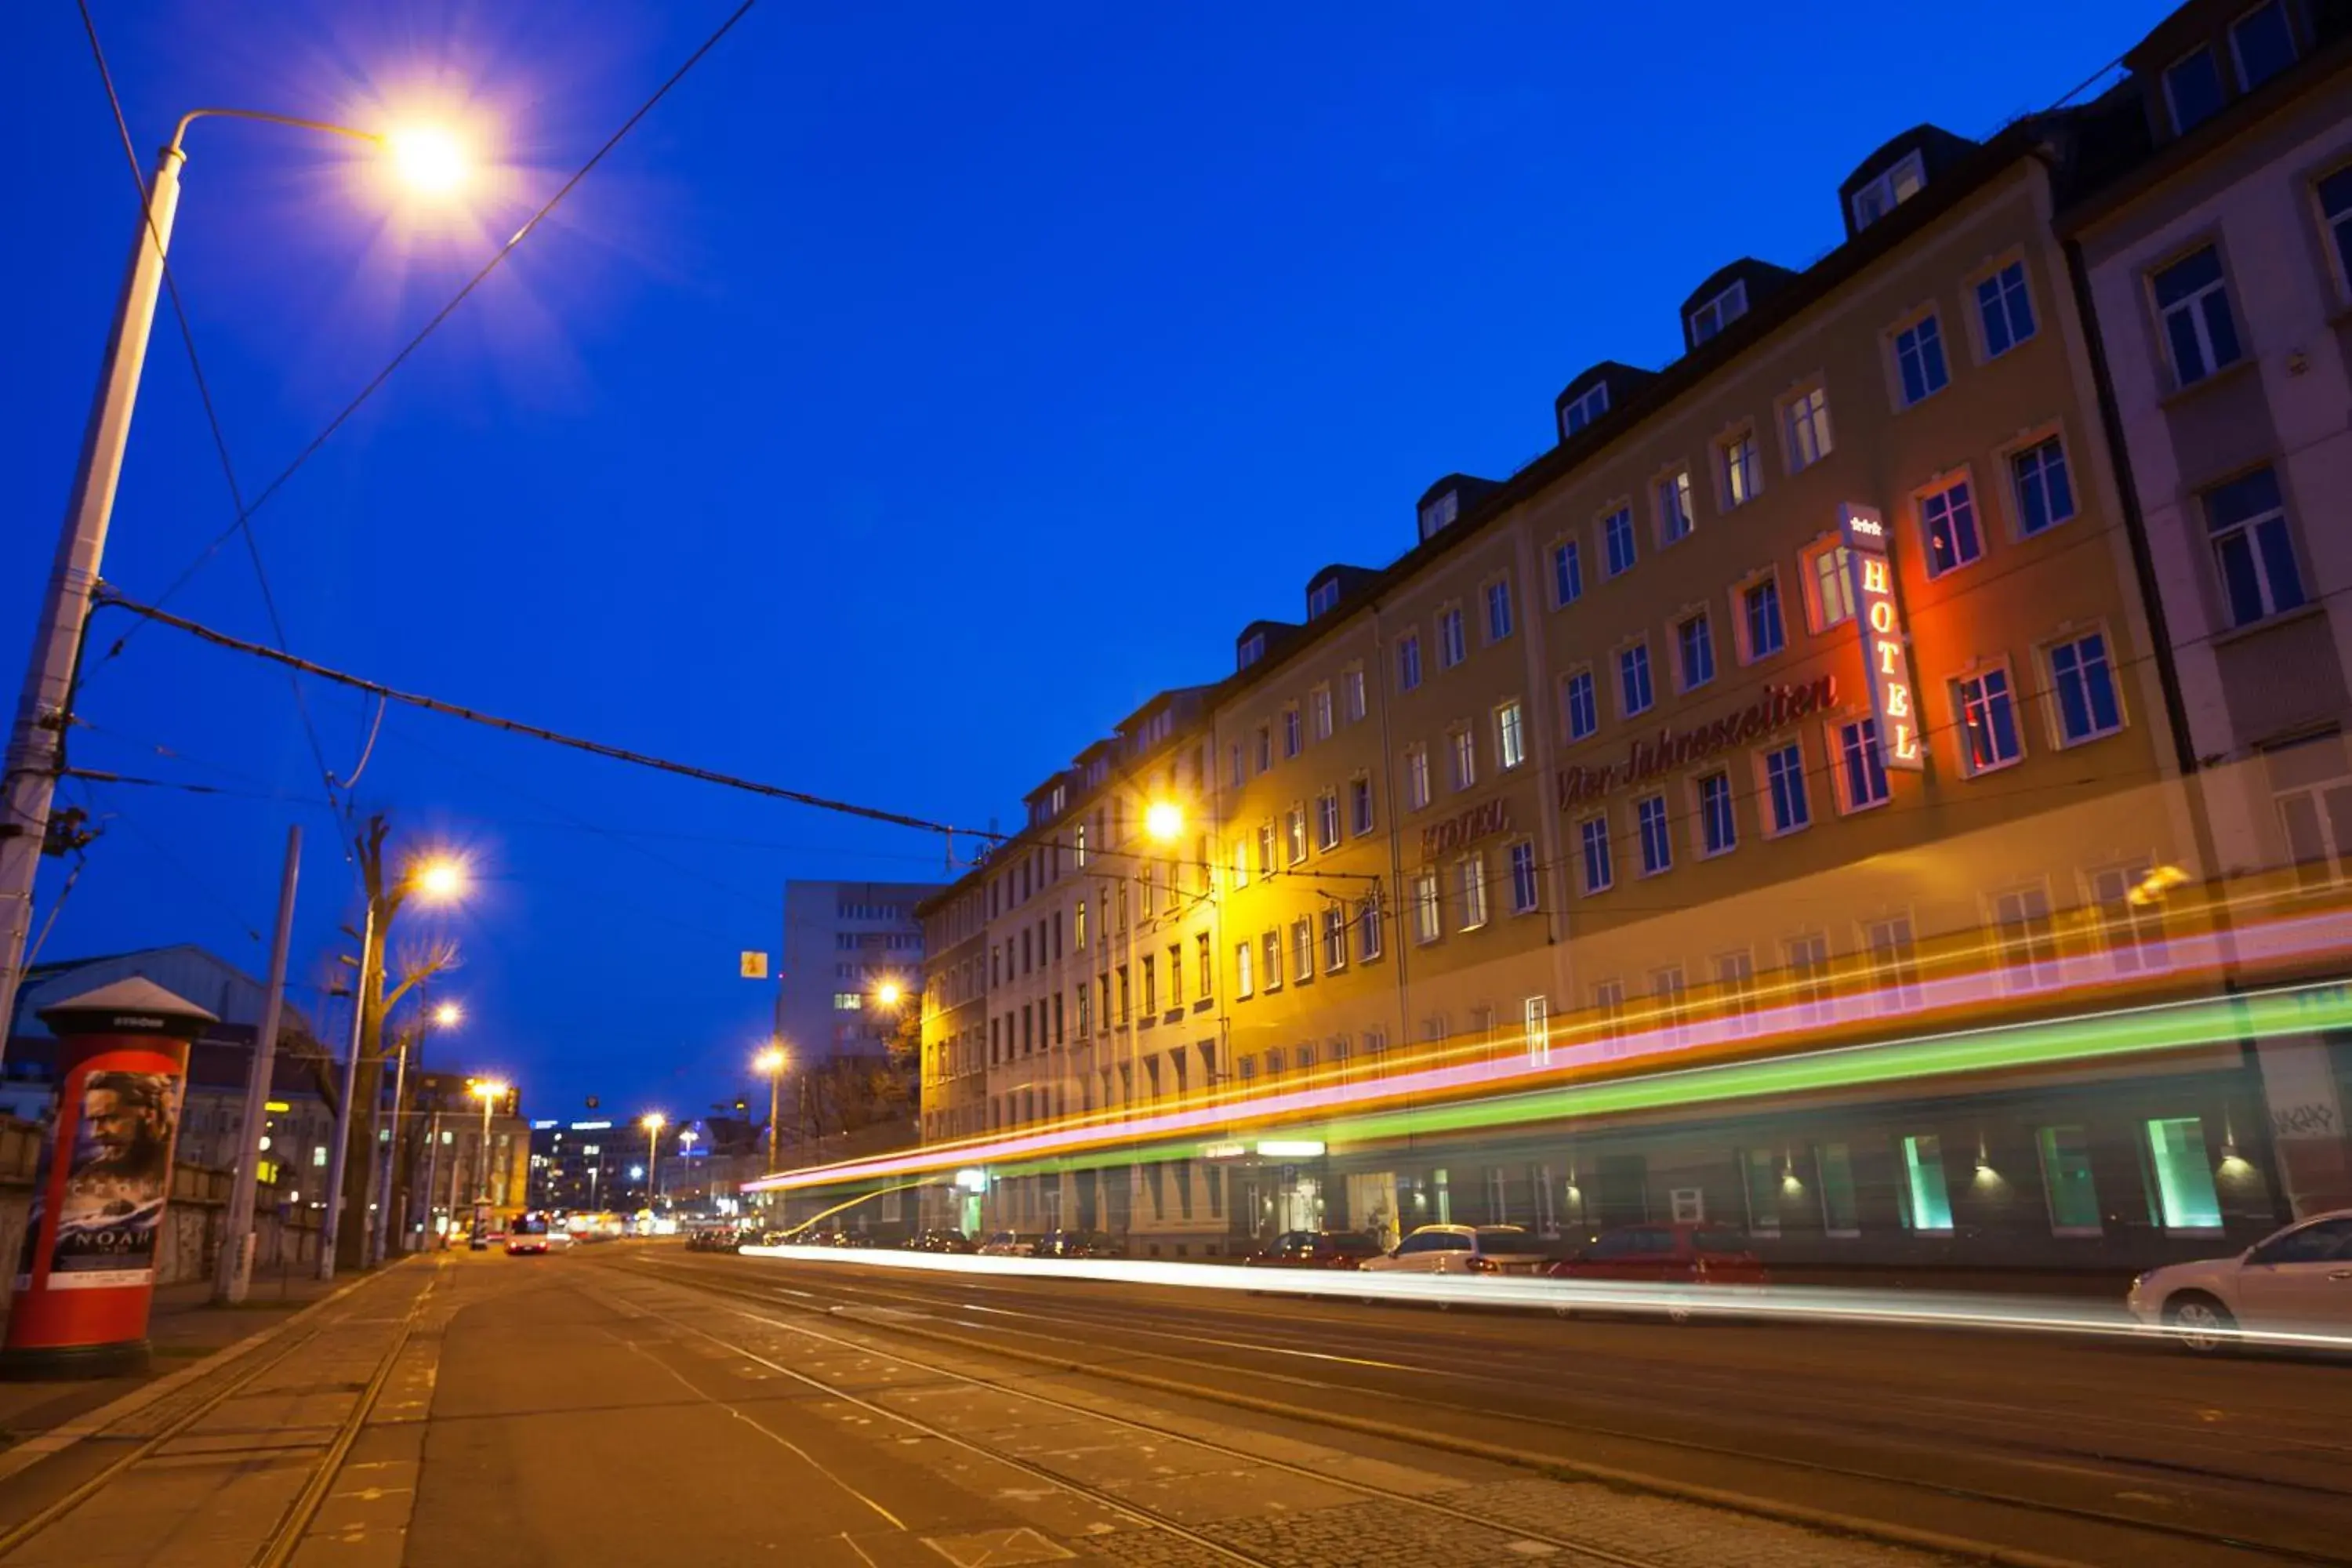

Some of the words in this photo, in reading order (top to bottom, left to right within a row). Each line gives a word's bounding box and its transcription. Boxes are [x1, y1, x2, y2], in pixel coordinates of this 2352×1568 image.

[1863, 558, 1917, 760] HOTEL
[1622, 674, 1839, 783] Jahreszeiten
[1421, 798, 1510, 863] HOTEL
[75, 1230, 150, 1246] NOAH
